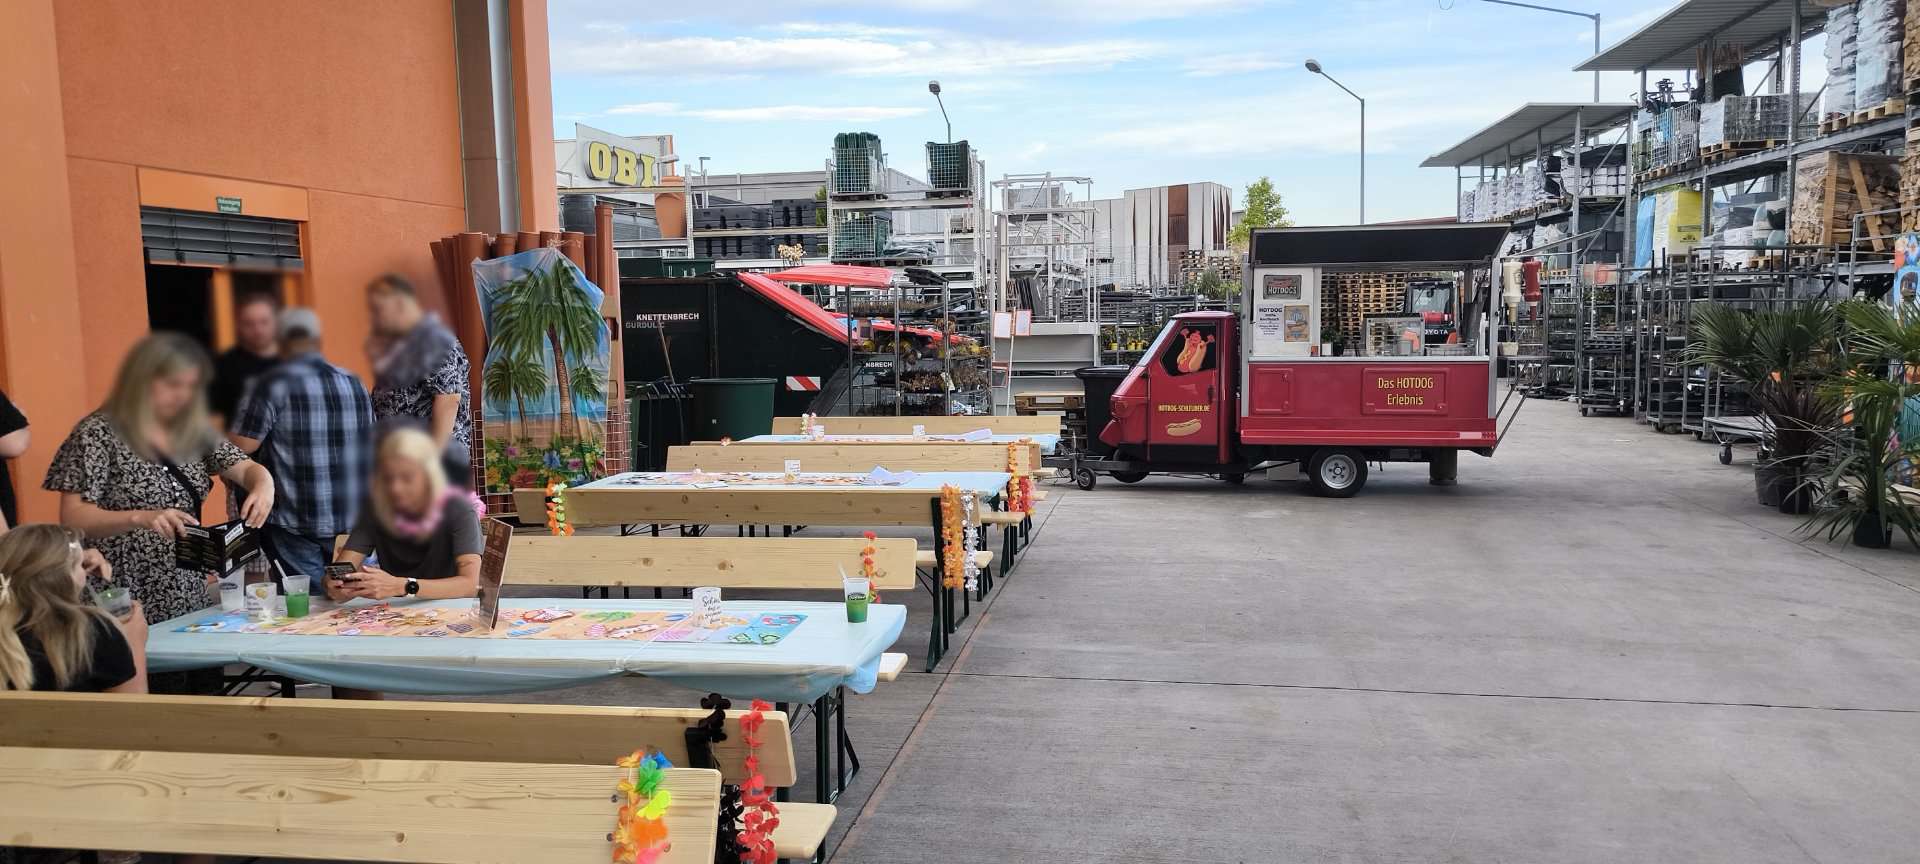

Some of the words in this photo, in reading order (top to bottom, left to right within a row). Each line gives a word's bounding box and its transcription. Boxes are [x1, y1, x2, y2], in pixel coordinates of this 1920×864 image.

[587, 141, 656, 187] OBI
[636, 313, 700, 321] KNETTENBRECH
[625, 321, 665, 329] GURDULC
[1378, 377, 1395, 389] Das
[1396, 377, 1434, 389] HOTDOG
[1387, 393, 1424, 405] Erlebnis
